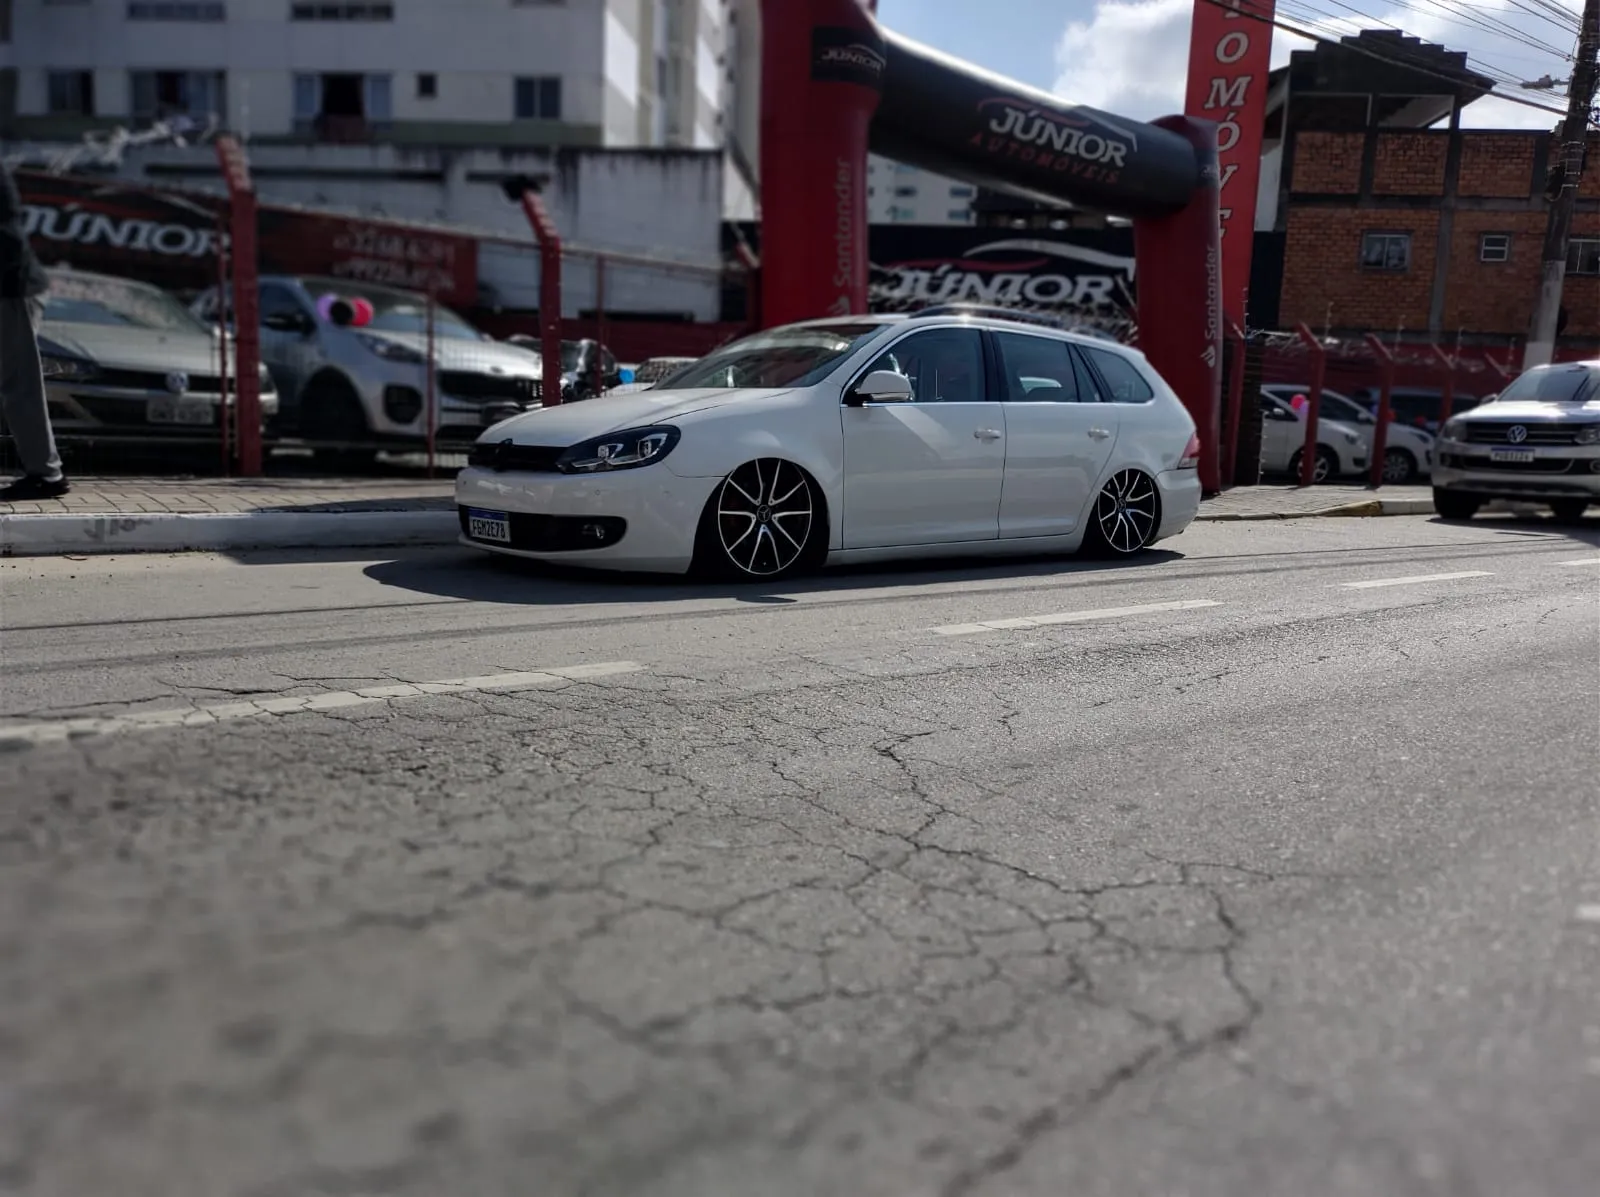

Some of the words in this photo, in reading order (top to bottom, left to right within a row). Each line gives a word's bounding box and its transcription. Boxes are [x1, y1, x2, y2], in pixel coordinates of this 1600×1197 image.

[969, 130, 1120, 185] AUTOMÓVEIS
[988, 106, 1128, 168] JÚNIOR
[833, 157, 852, 288] Santander
[886, 263, 1117, 303] JÚNIOR
[1204, 243, 1218, 340] Santander
